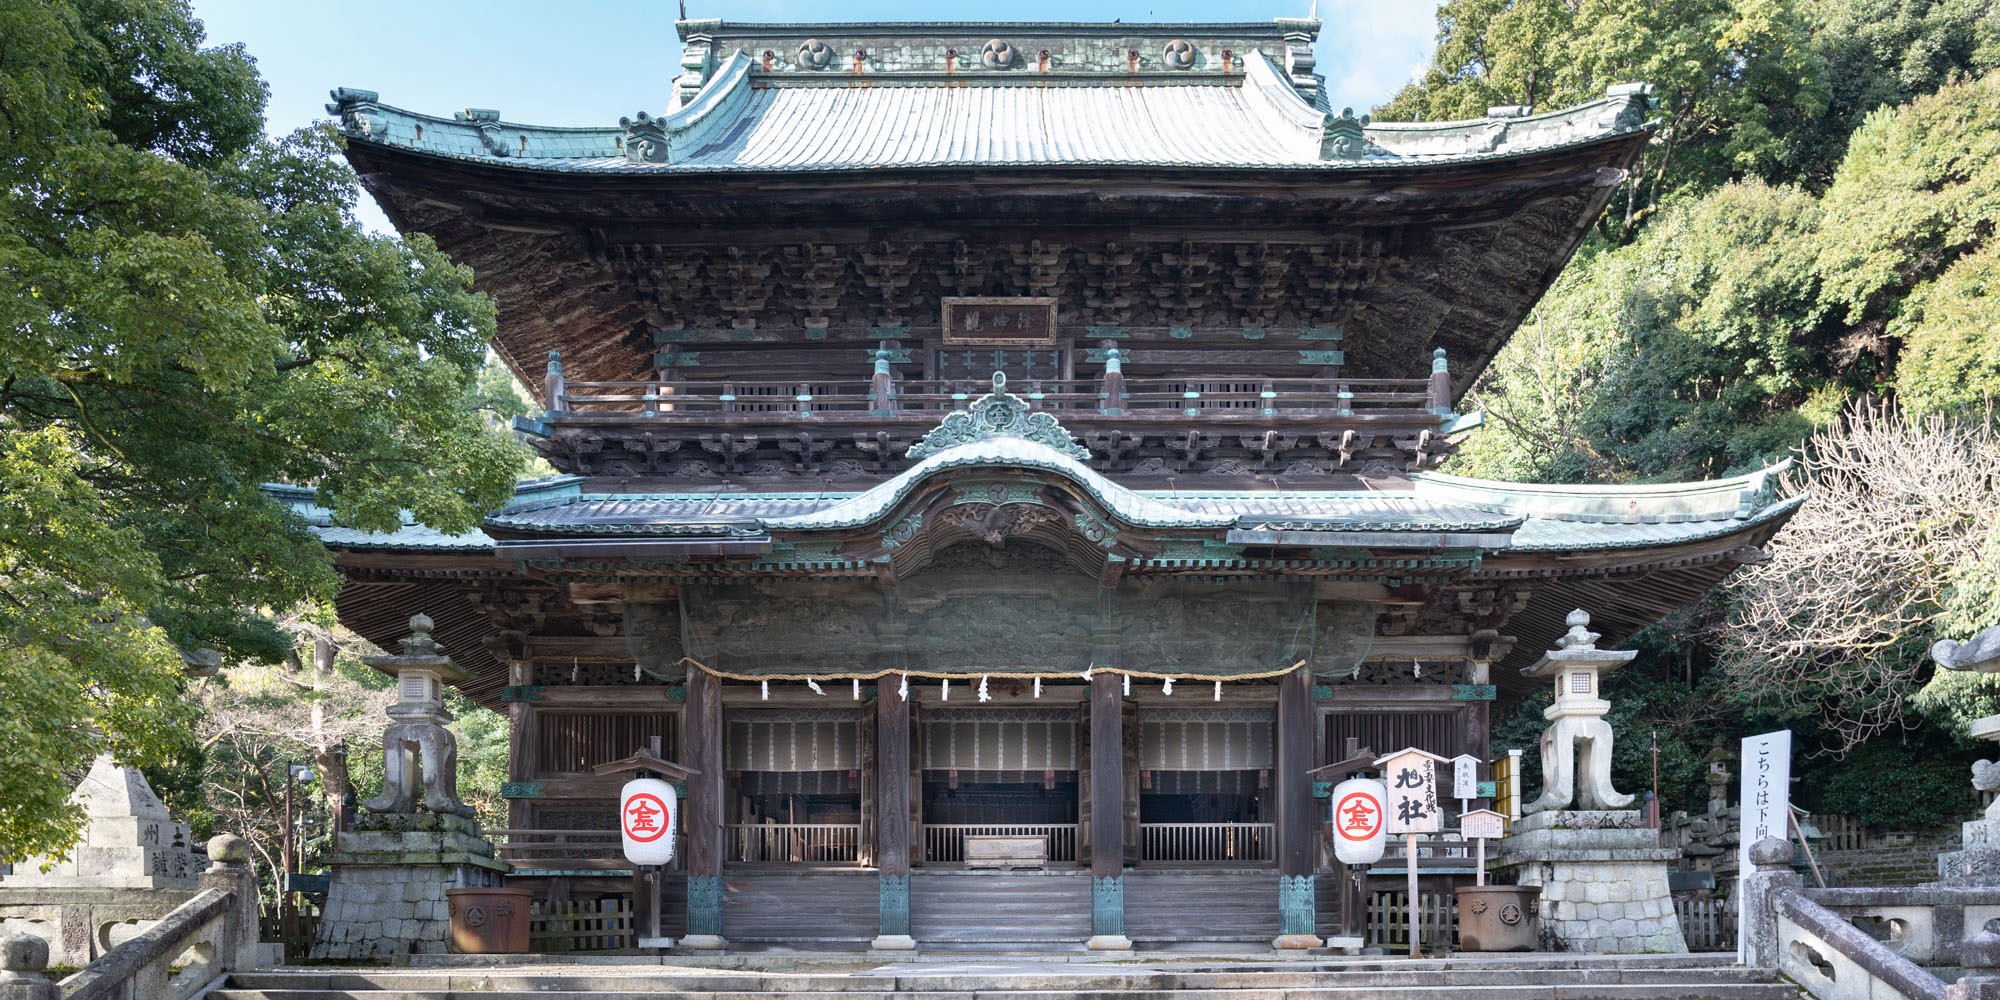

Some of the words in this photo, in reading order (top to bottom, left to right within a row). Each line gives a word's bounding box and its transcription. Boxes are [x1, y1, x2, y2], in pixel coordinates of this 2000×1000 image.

[1394, 767, 1428, 825] 旭社
[1422, 759, 1437, 814] 重要文化財
